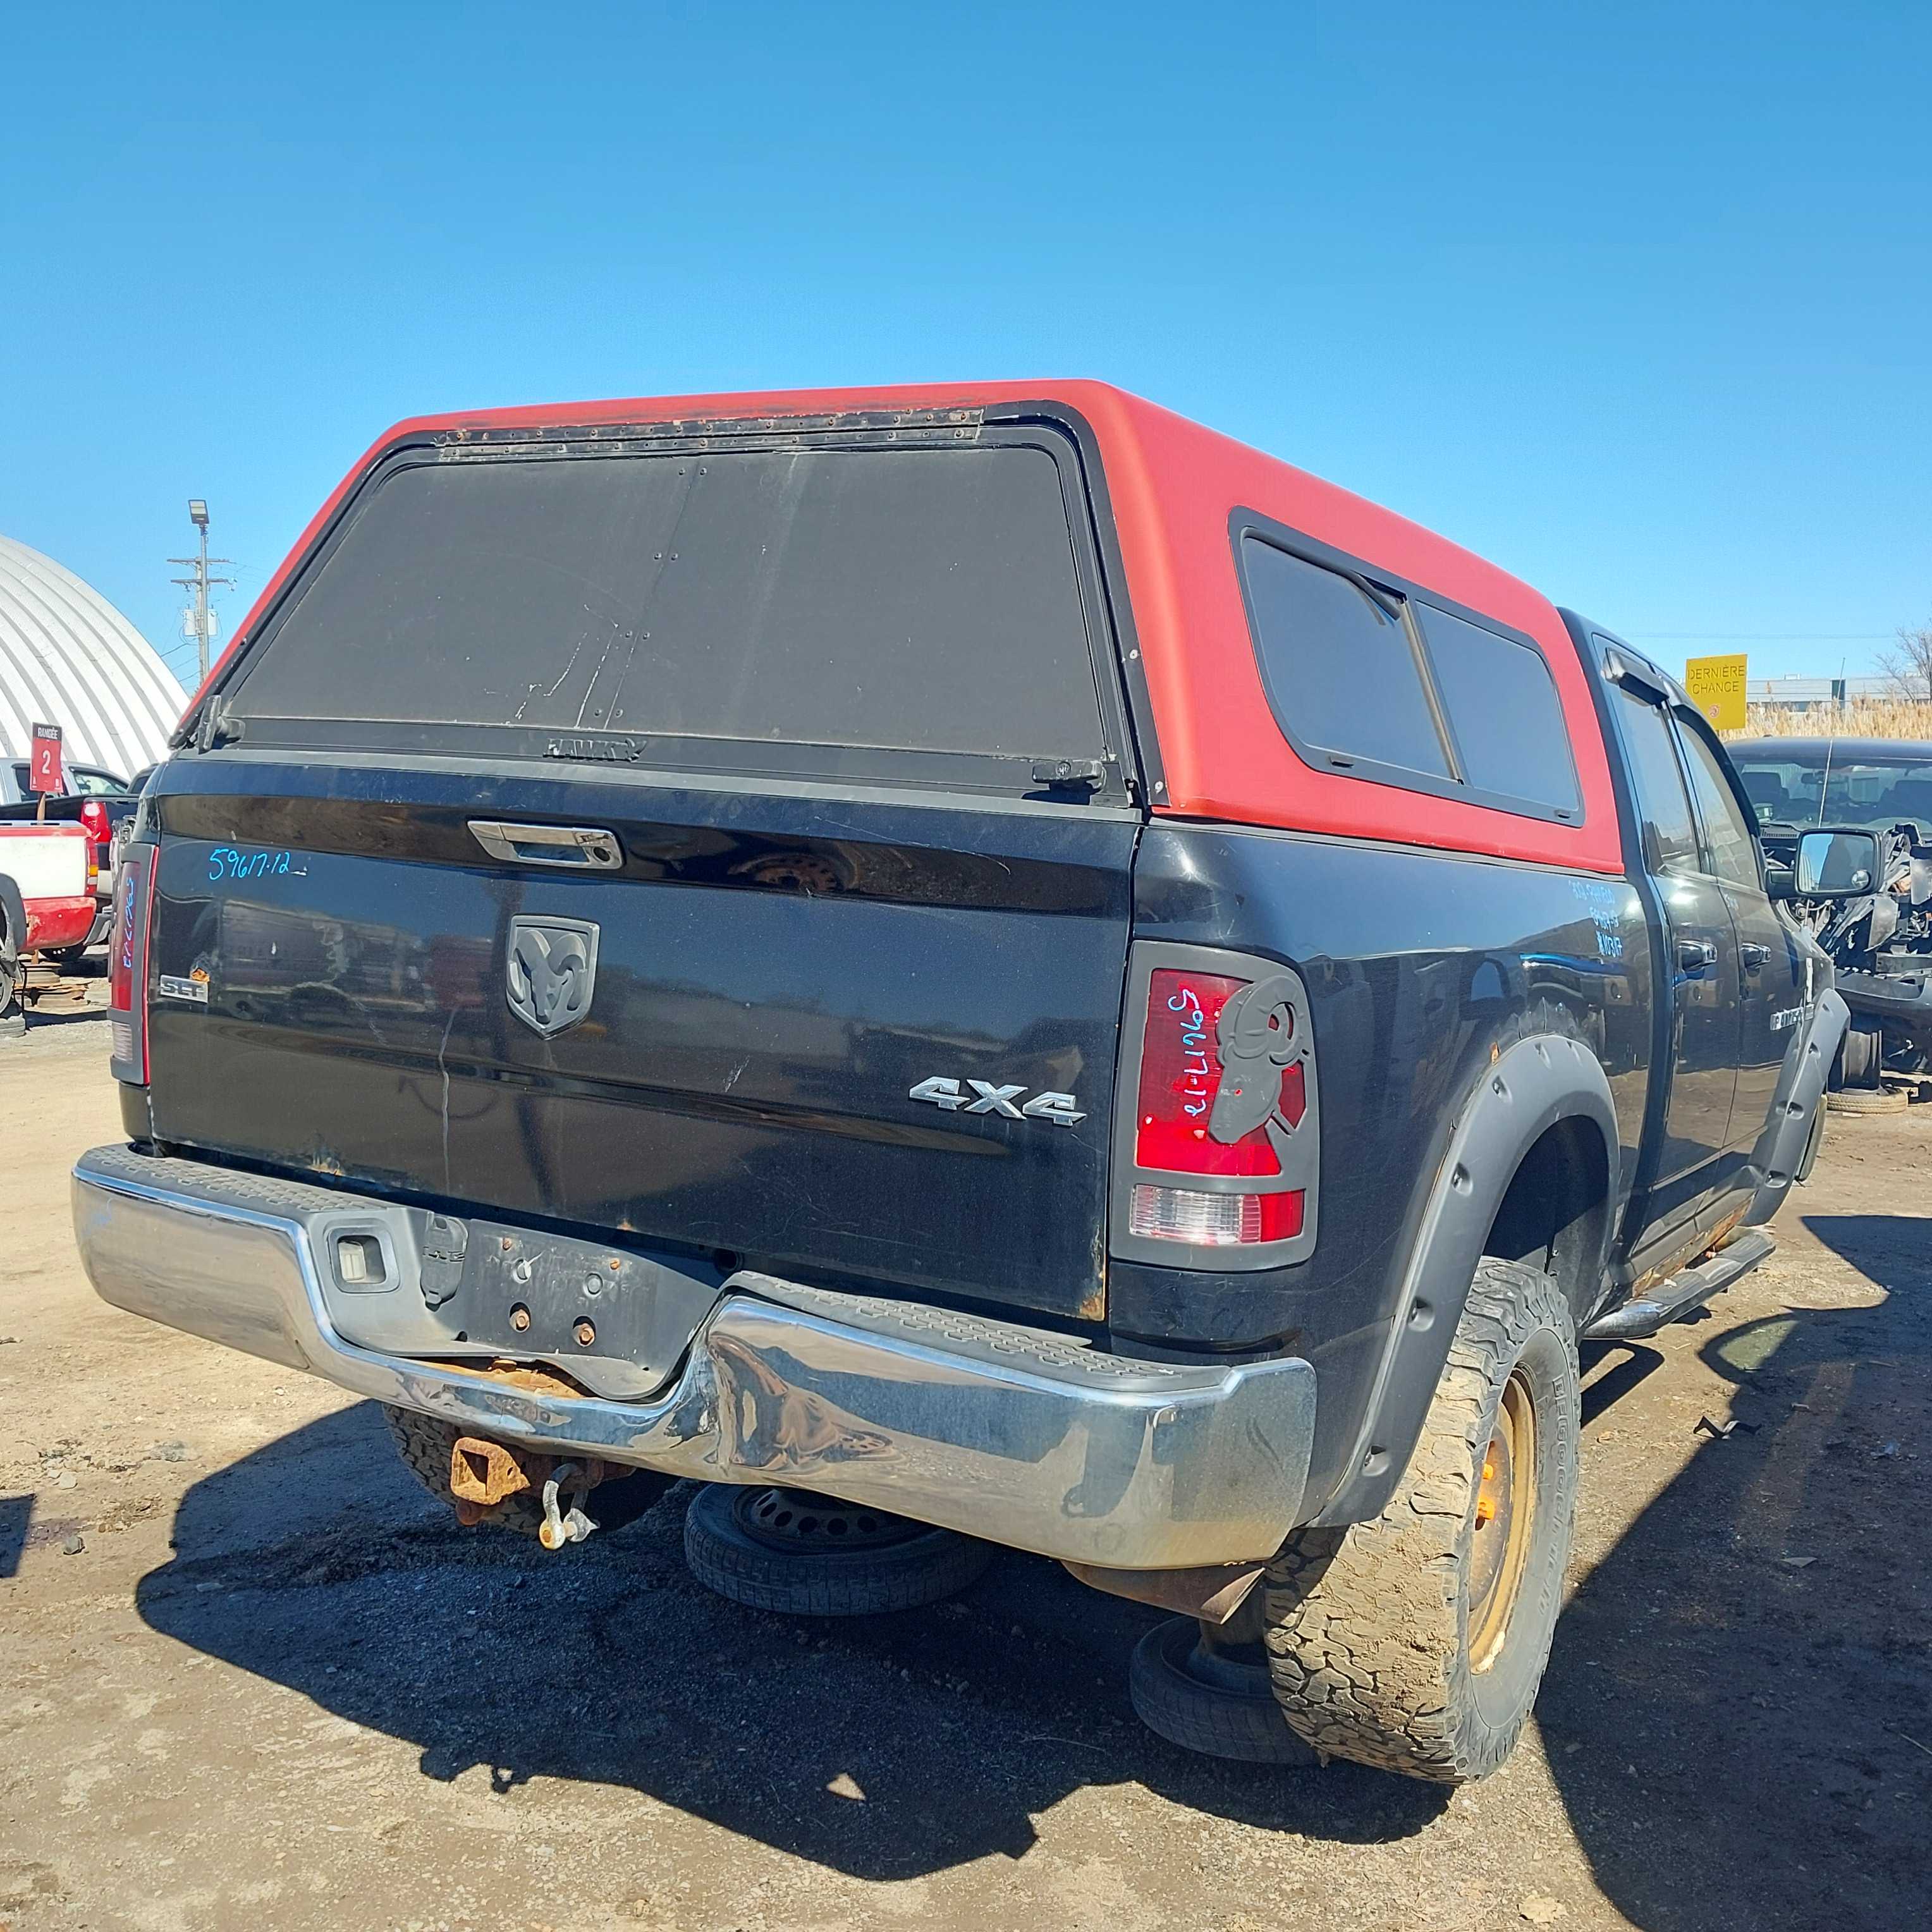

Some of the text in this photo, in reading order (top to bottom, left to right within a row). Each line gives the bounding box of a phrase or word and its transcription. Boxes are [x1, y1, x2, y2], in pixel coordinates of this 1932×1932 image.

[1687, 665, 1745, 680] DERNIÈRE
[1692, 681, 1739, 694] CHANCE
[42, 750, 51, 774] 2
[161, 979, 205, 998] SLT
[909, 1076, 1087, 1127] 4X4
